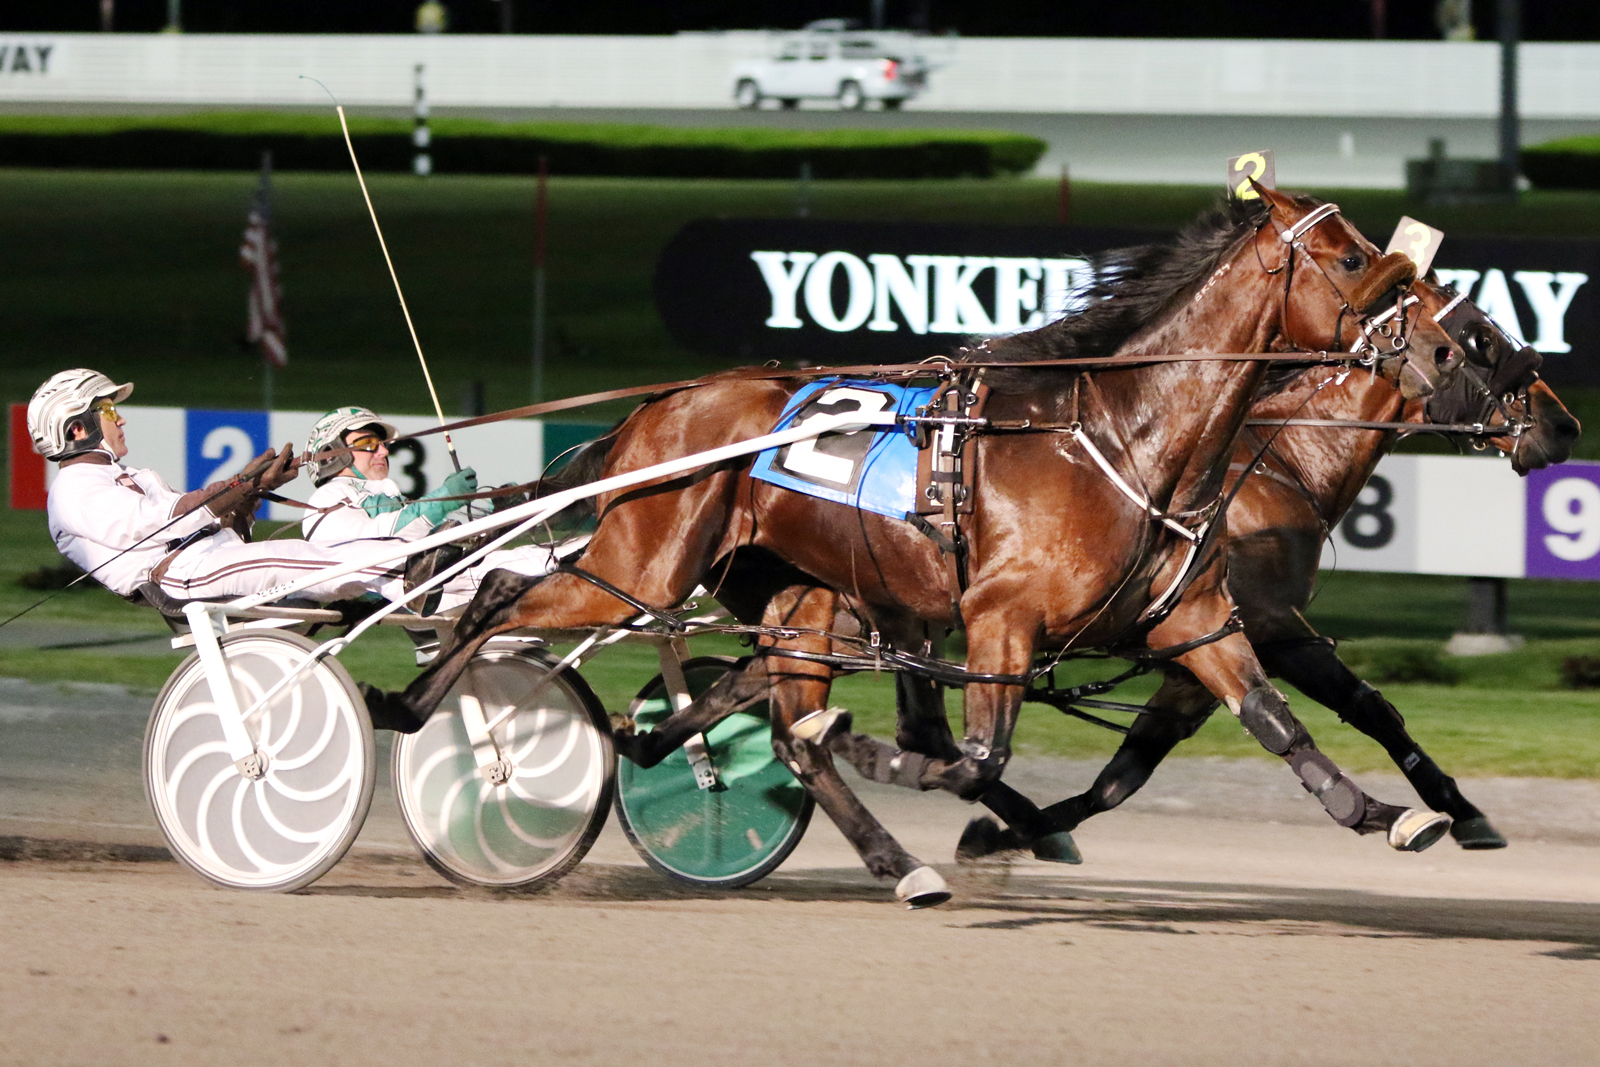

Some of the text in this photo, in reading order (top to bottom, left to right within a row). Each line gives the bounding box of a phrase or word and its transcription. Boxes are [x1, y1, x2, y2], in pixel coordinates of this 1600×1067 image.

[1235, 152, 1266, 199] 2
[1394, 222, 1432, 269] 3
[783, 388, 888, 484] 2
[202, 426, 1600, 561] 2 3 8 9
